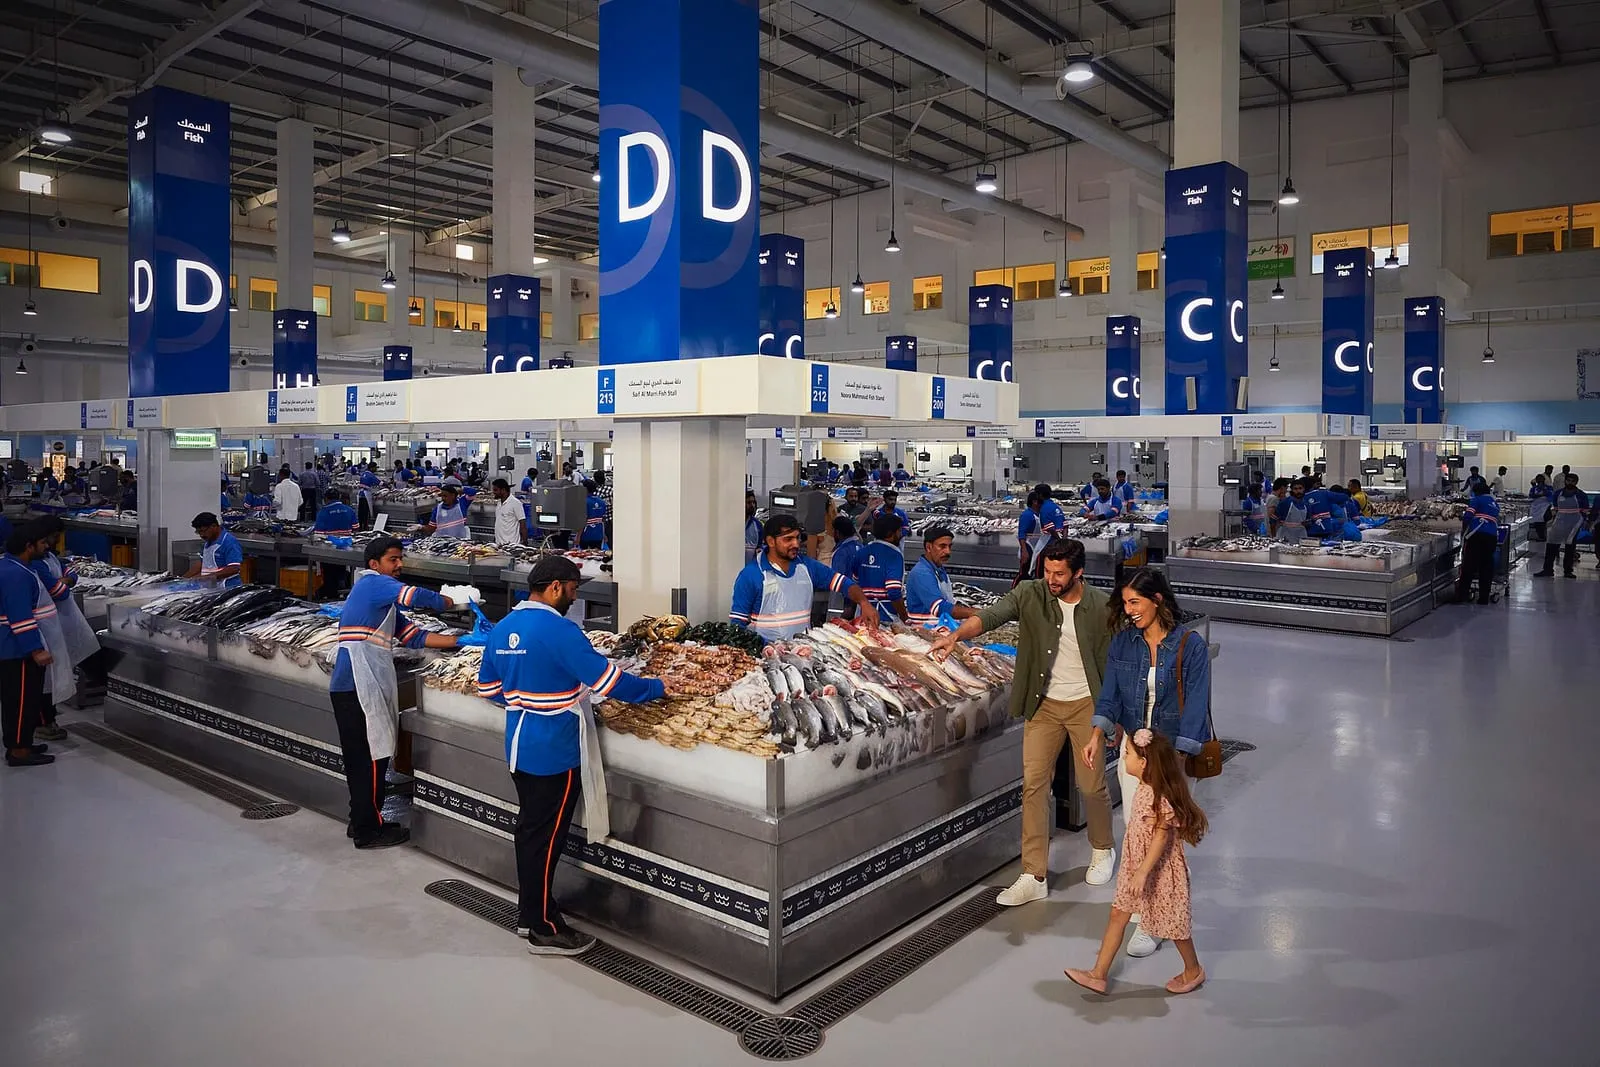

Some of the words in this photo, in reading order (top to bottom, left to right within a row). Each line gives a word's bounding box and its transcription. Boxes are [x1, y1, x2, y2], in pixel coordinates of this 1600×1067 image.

[177, 119, 211, 132] السمك
[184, 131, 204, 144] Fish
[619, 132, 670, 222] D
[703, 130, 751, 222] D
[1182, 185, 1208, 196] السمك
[1187, 196, 1203, 205] Fish
[1089, 261, 1105, 272] food
[135, 260, 153, 312] D
[177, 260, 222, 312] D
[1181, 298, 1213, 342] C
[1230, 299, 1244, 343] C
[1334, 341, 1360, 373] C
[975, 360, 994, 383] C
[603, 377, 610, 388] F
[818, 374, 823, 385] F
[1412, 366, 1433, 391] C
[667, 389, 678, 397] Stall
[936, 386, 941, 395] F
[1112, 376, 1129, 399] C
[350, 393, 354, 402] F
[600, 393, 614, 404] 213
[813, 390, 827, 402] 212
[347, 405, 356, 415] 214
[932, 400, 944, 410] 200
[268, 407, 277, 416] 215
